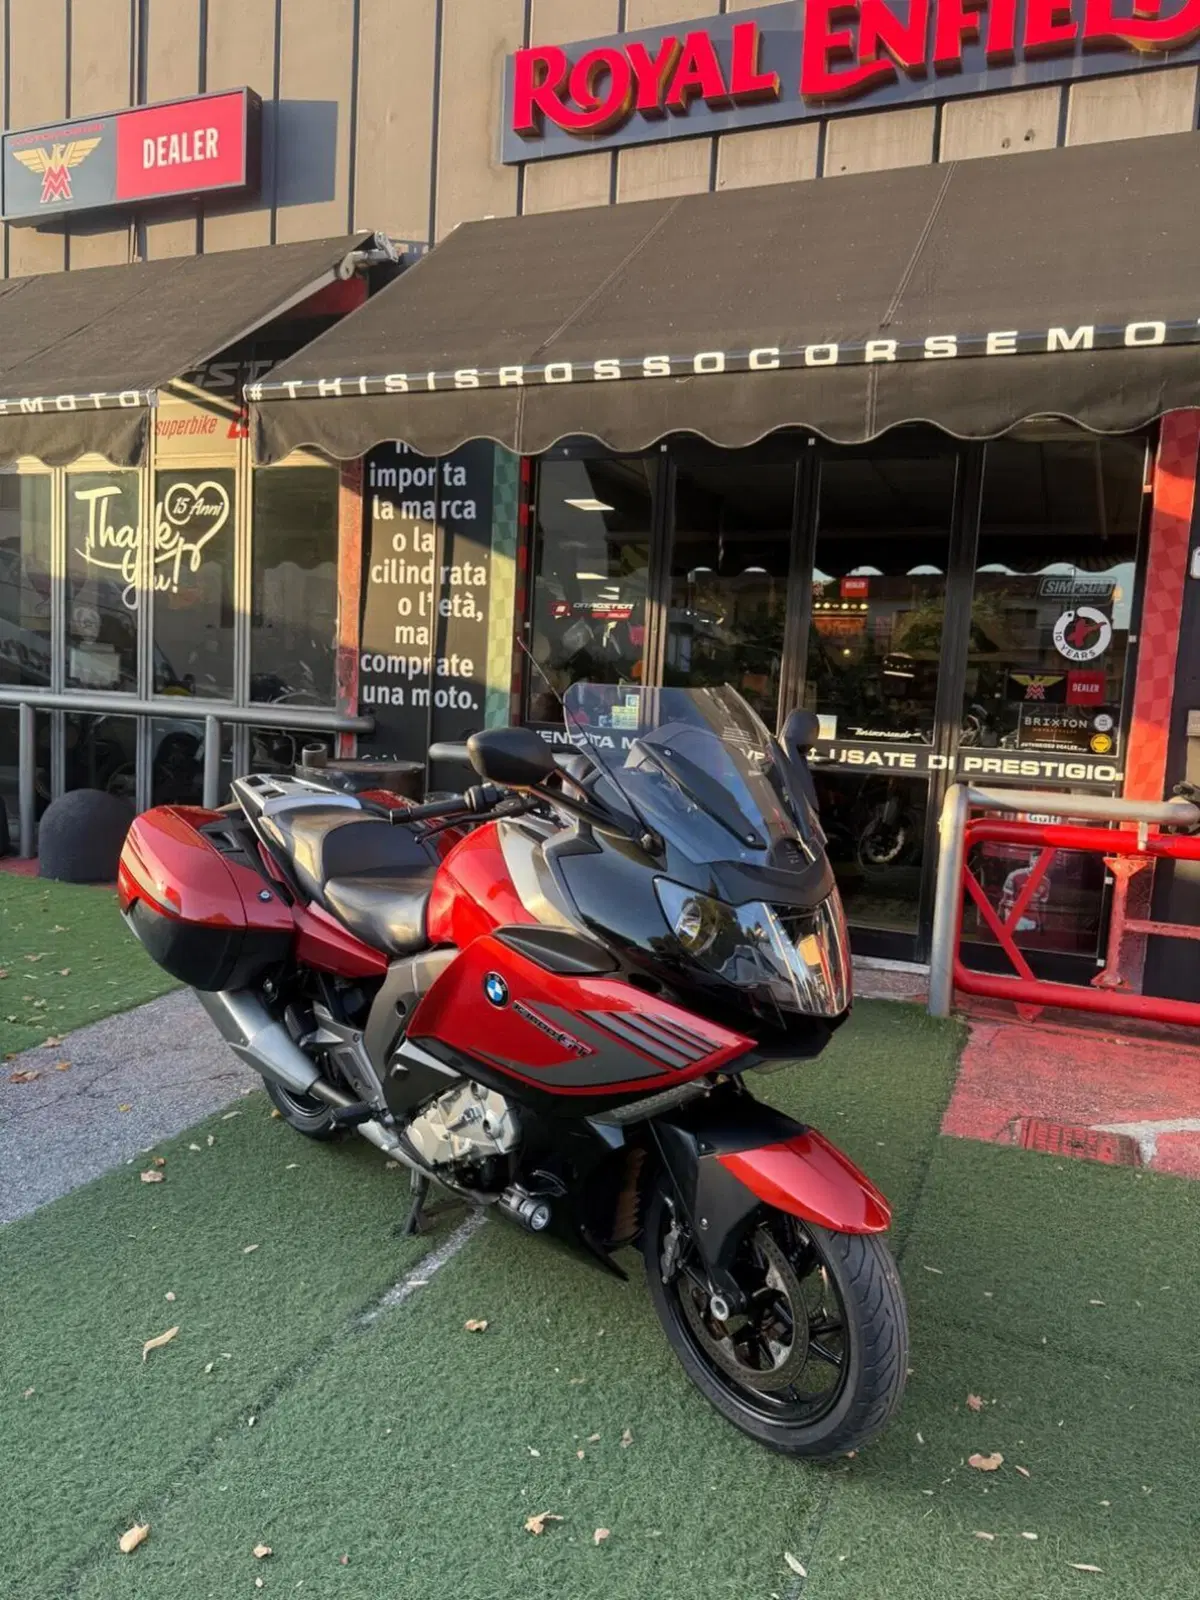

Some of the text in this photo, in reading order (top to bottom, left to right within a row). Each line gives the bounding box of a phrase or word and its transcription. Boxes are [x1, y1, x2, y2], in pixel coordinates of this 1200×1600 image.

[513, 22, 780, 136] ROYAL
[142, 127, 219, 169] DEALER
[250, 318, 1200, 400] #THISISROSSOCORSEMO
[156, 415, 218, 440] superbike
[369, 462, 466, 493] importa
[173, 497, 224, 516] 15 Anni
[373, 494, 476, 520] la marca
[392, 526, 434, 552] o la
[121, 537, 184, 610] Yu!
[371, 558, 487, 586] cilindrata
[1046, 579, 1107, 594] SIMPSON
[397, 597, 412, 616] o
[395, 625, 429, 645] ma
[1061, 643, 1097, 660] YEARS
[360, 653, 474, 680] comprate
[363, 685, 479, 710] una moto.
[1072, 682, 1100, 692] DEALER
[1024, 716, 1088, 729] BRIXTON
[536, 730, 616, 749] ENDITA
[829, 748, 1117, 781] USATE DI PRESTIGIO
